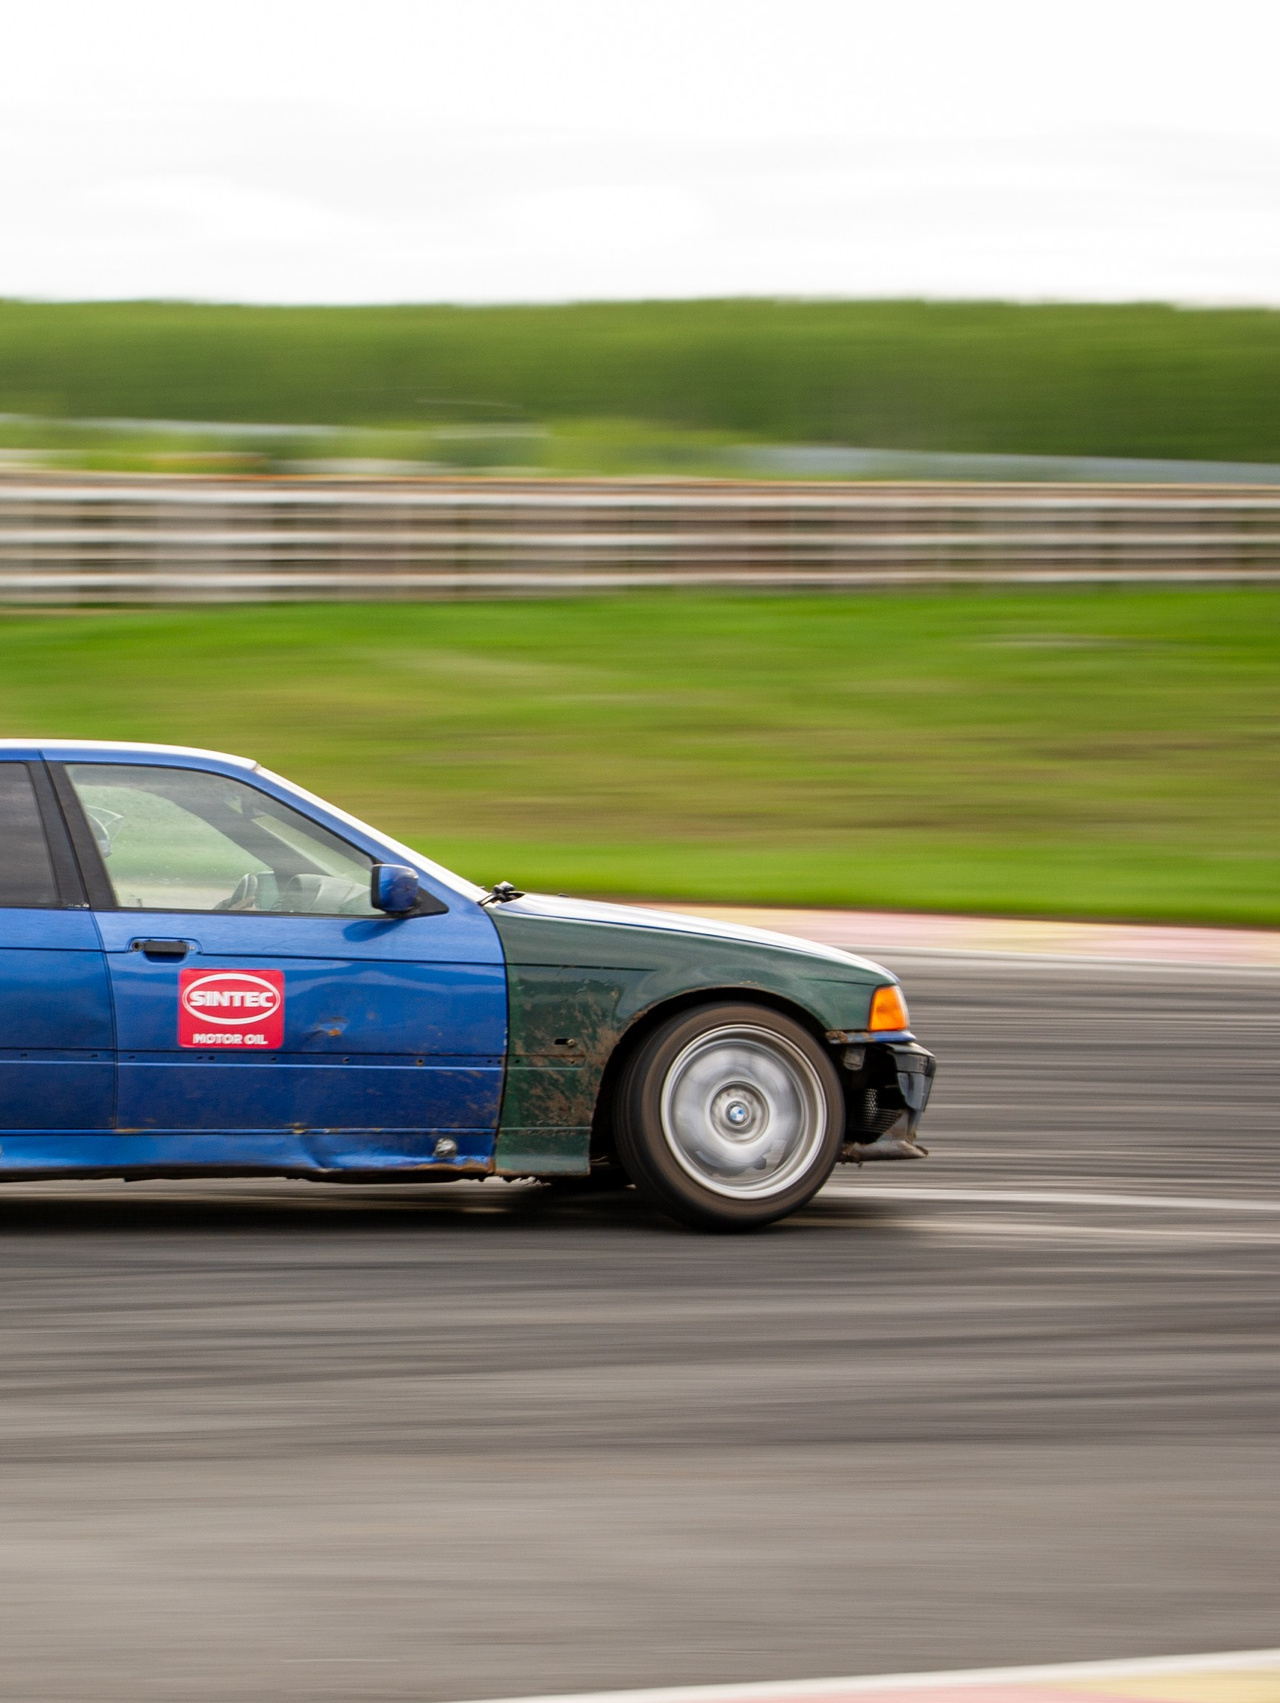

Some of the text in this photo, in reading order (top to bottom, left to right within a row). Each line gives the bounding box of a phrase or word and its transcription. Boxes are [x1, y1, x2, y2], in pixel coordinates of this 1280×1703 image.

[189, 990, 274, 1008] SINTEC
[192, 1033, 269, 1046] MOTOR OIL
